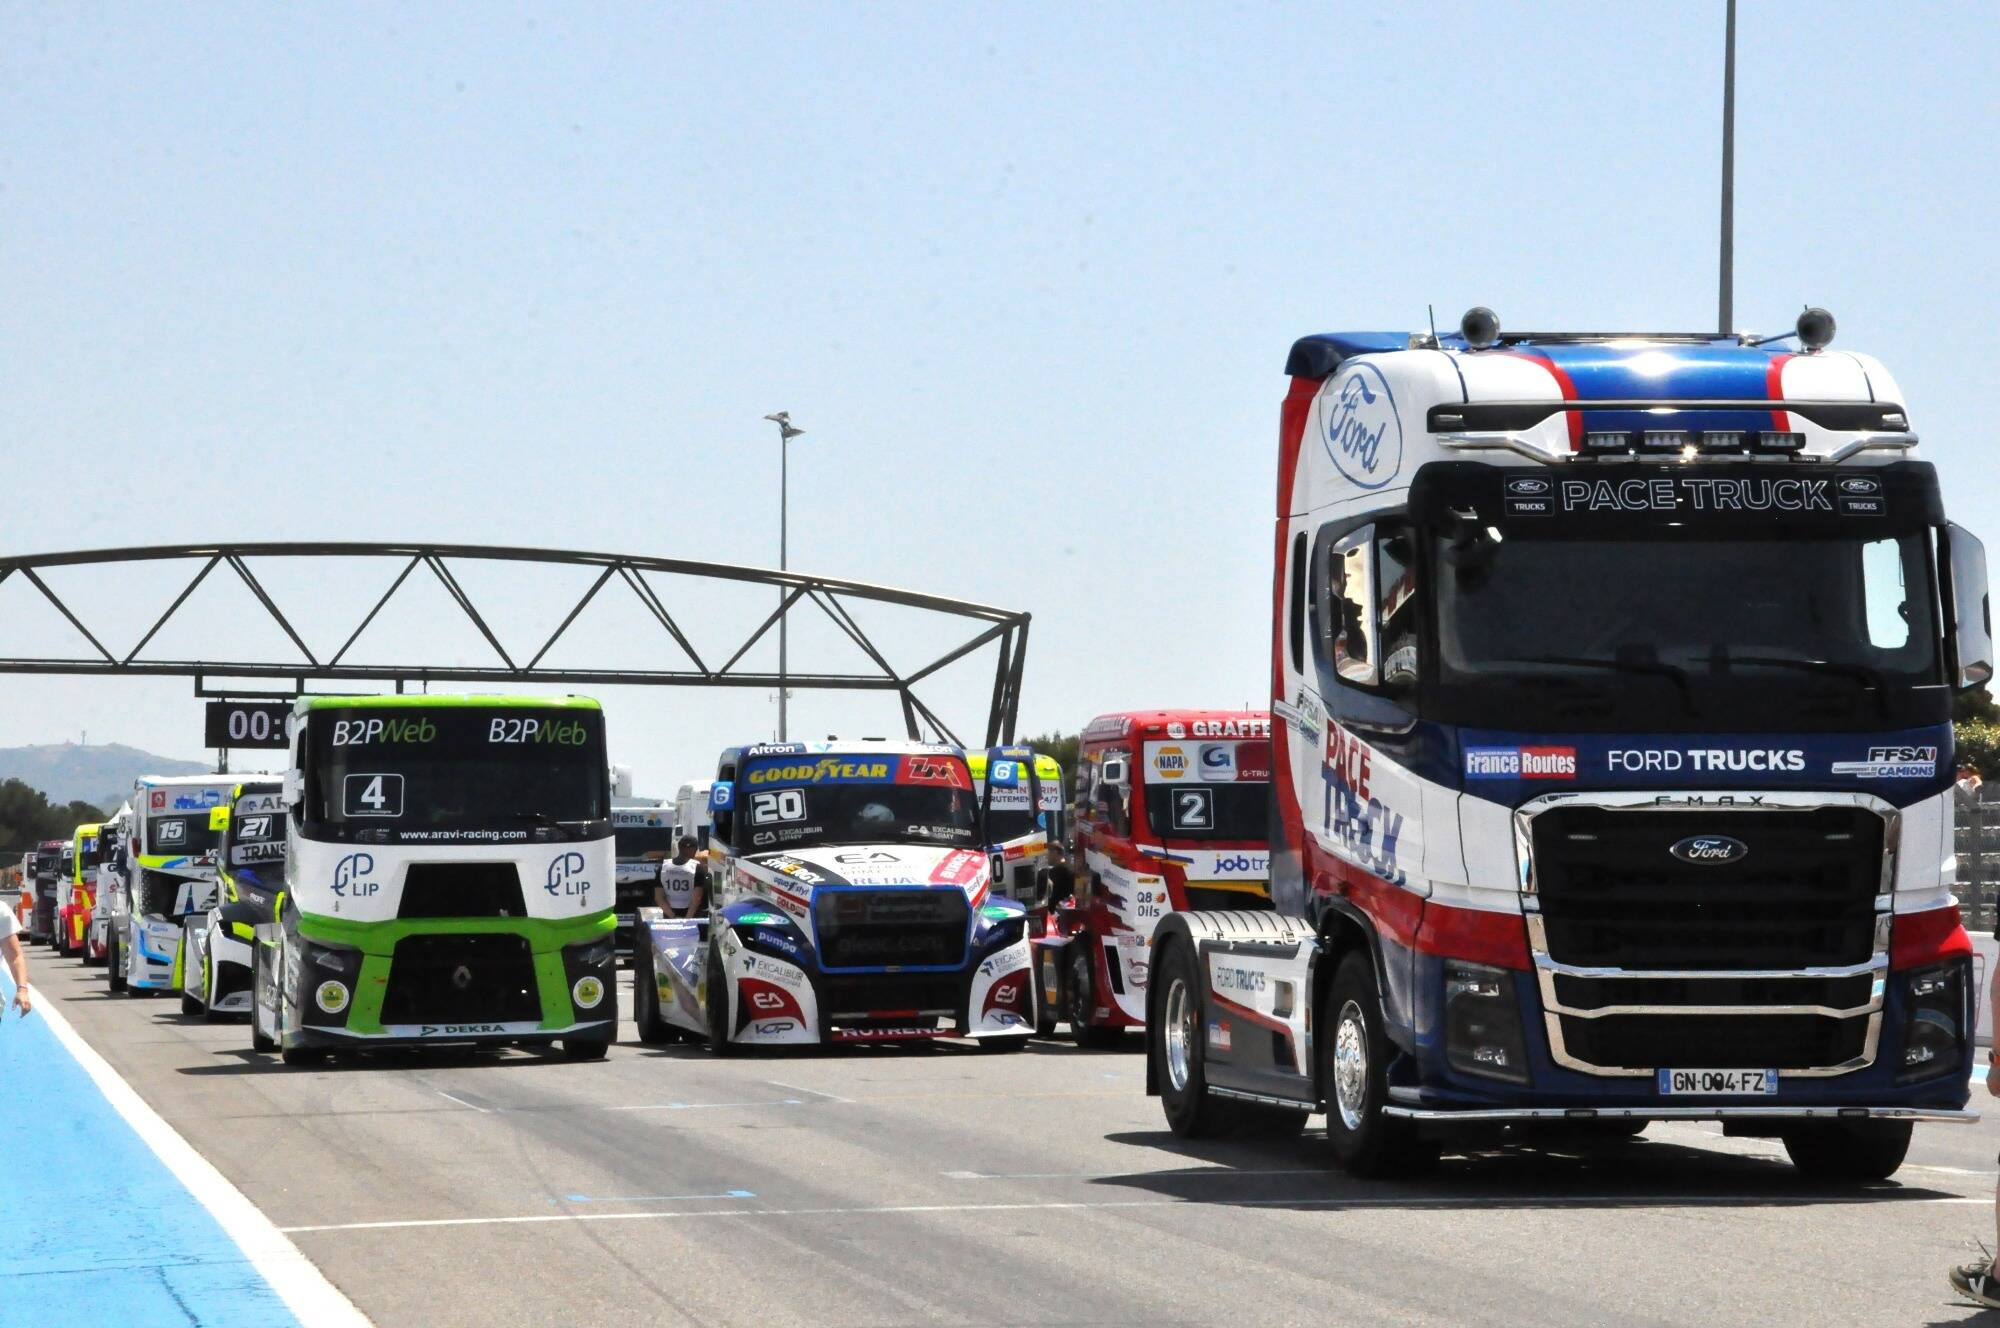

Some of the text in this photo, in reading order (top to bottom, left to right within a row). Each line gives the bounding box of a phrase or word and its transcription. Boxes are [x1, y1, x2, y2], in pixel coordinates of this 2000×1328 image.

[1330, 373, 1386, 474] Ford
[1516, 480, 1541, 492] Ford
[1848, 481, 1875, 492] Ford
[1562, 479, 1833, 511] PACE TRUCK
[1515, 503, 1545, 511] TRUCKS
[1848, 502, 1877, 510] TRUCKS
[332, 718, 436, 746] B2PWeb
[488, 718, 587, 745] B2PWeb
[748, 743, 795, 755] Altron
[1870, 748, 1932, 761] FFSA
[1159, 756, 1184, 769] NAPA
[1326, 719, 1371, 801] PACE
[1467, 752, 1576, 774] France Routes
[1608, 750, 1805, 771] FORD TRUCKS
[749, 759, 888, 784] GOODYEAR
[1242, 769, 1269, 777] G-TRU
[1877, 766, 1934, 777] CAMIONS
[361, 776, 385, 808] 4
[754, 791, 802, 823] 20
[1180, 794, 1205, 825] 2
[160, 822, 183, 839] 15
[240, 817, 270, 837] 21
[779, 826, 823, 836] EXCALIBUR
[933, 826, 972, 837] EXCALIBUR
[400, 829, 528, 841] www.aravi-racing.com
[1689, 840, 1731, 858] Ford
[353, 883, 379, 896] LIP
[566, 881, 591, 895] LIP
[665, 879, 690, 892] 103
[1137, 891, 1153, 903] Q8
[1137, 905, 1160, 917] Oils
[759, 932, 797, 953] pumpa
[758, 961, 804, 979] EXCALIBUR
[1217, 967, 1265, 992] FORD TRUCKS
[445, 1024, 505, 1035] DEKRA
